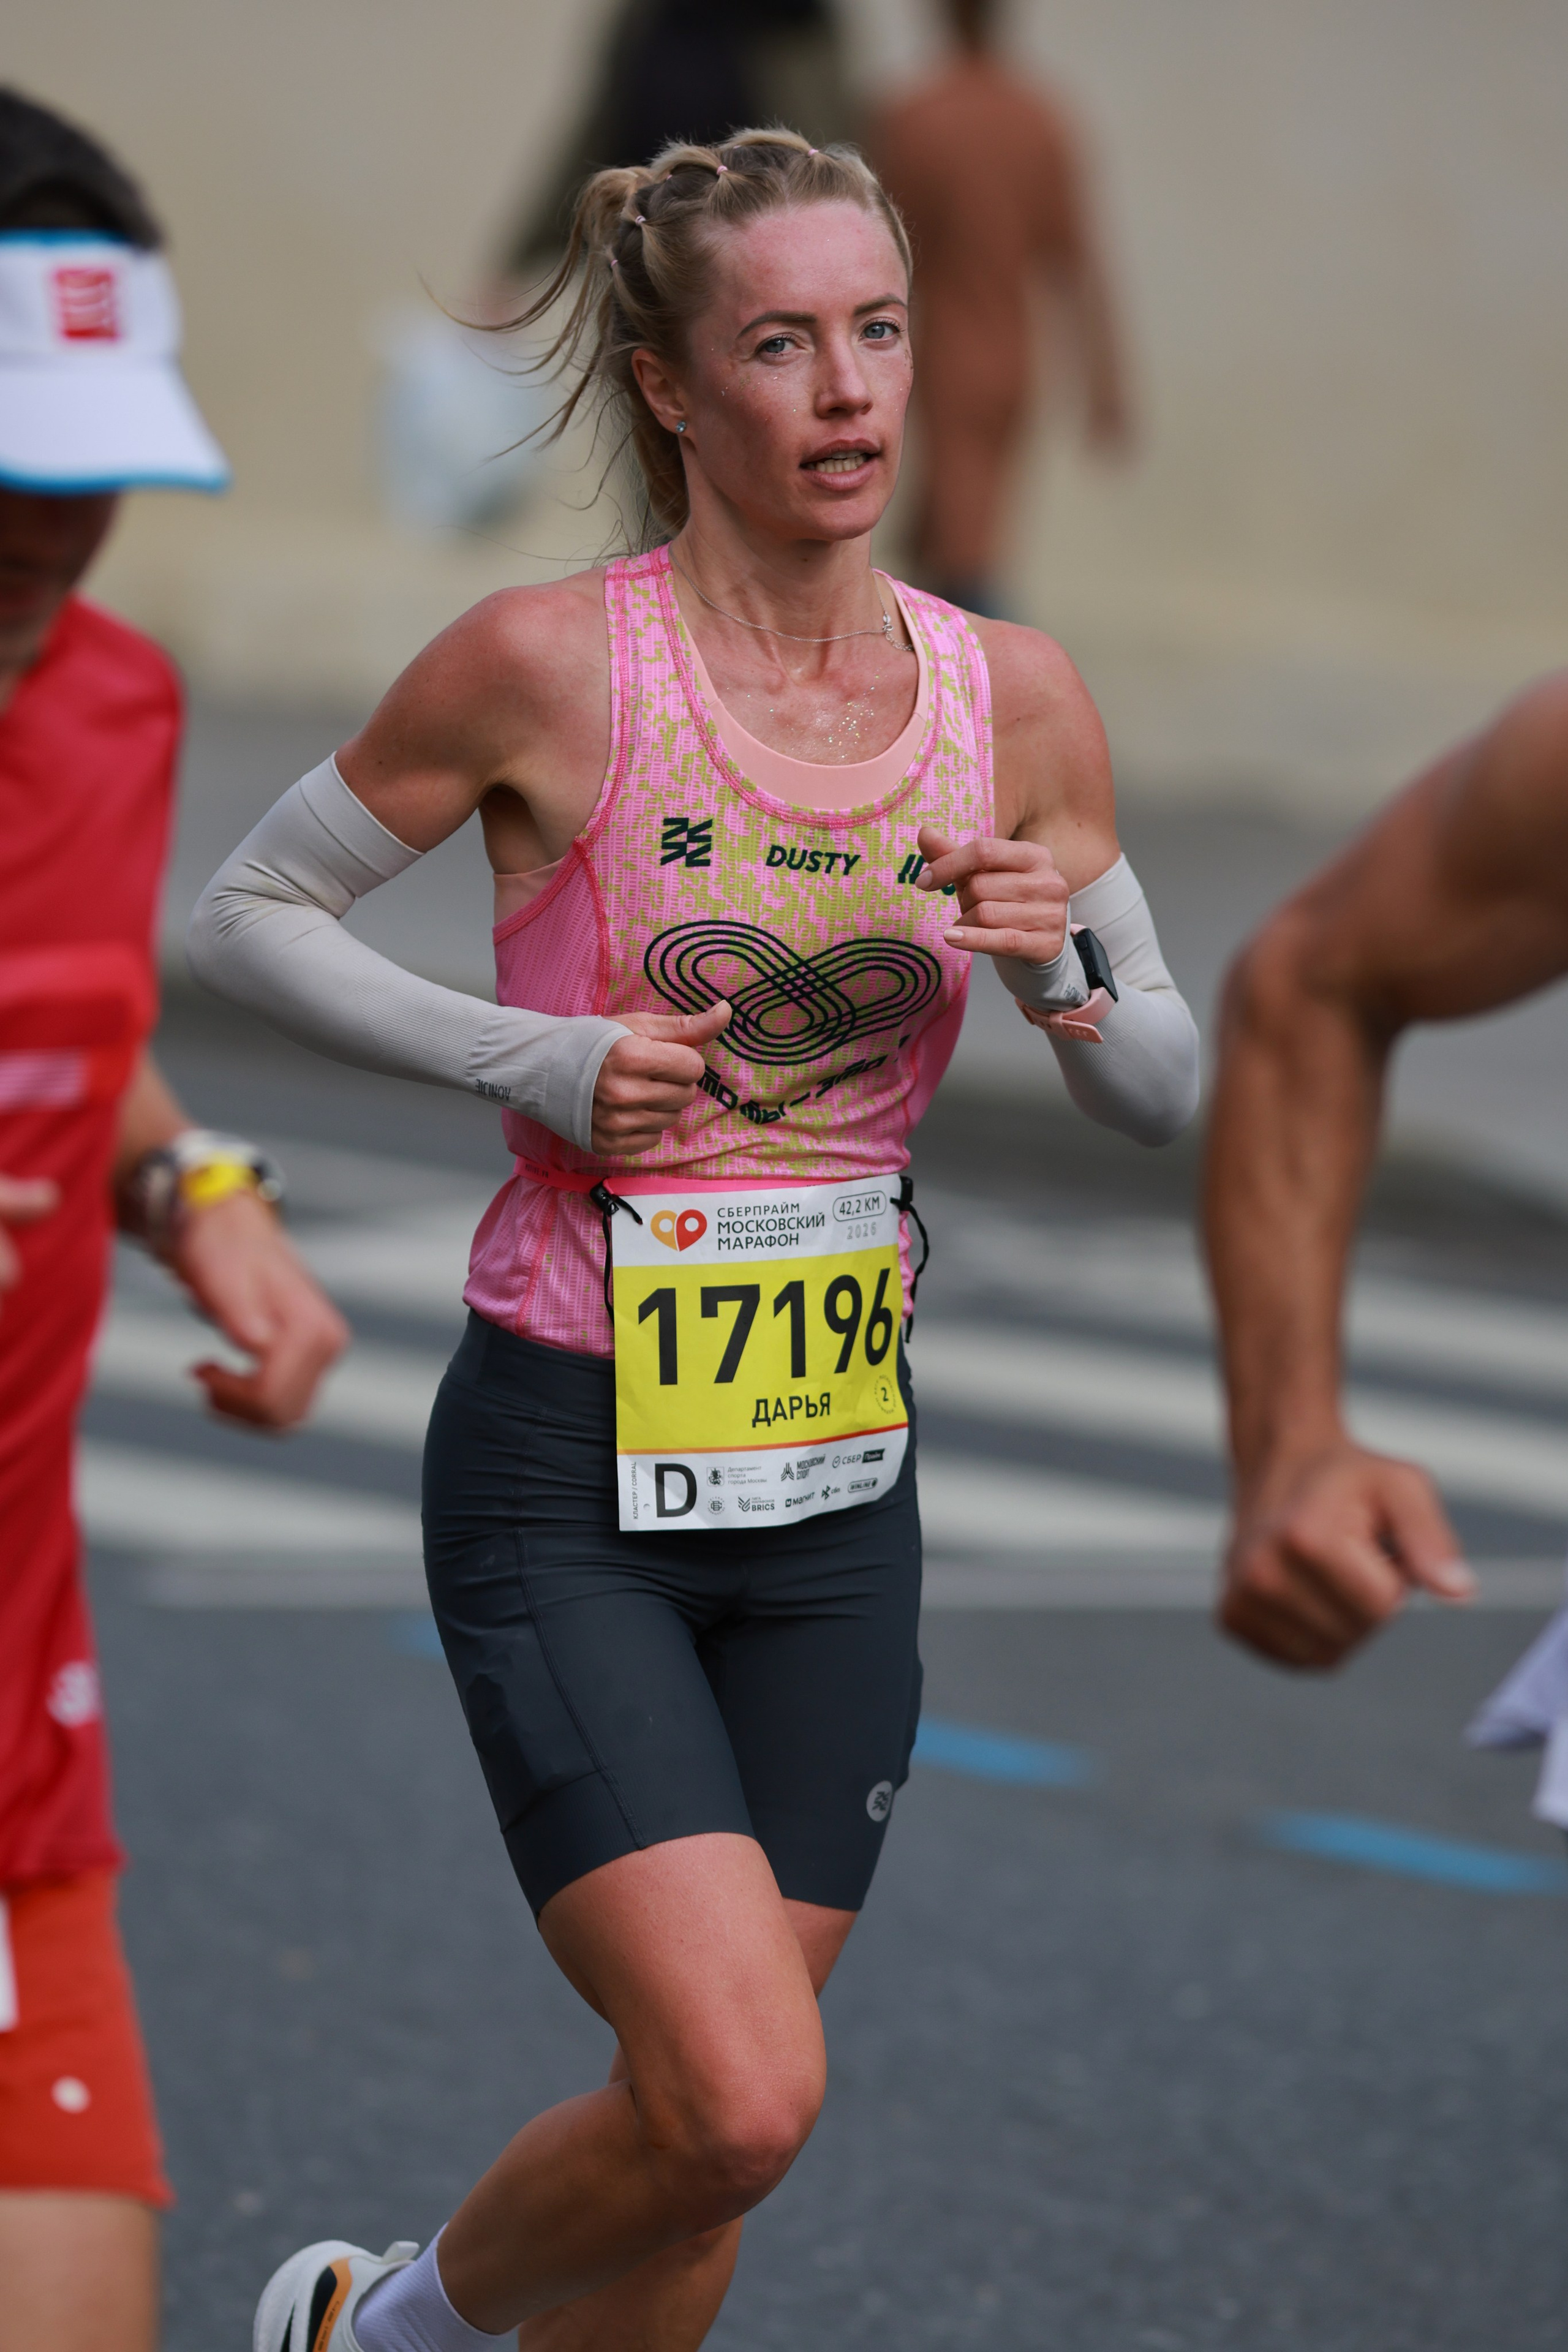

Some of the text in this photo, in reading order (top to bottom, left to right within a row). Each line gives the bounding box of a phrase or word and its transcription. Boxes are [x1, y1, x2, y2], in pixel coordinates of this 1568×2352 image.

[766, 845, 861, 875] DUSTY
[475, 1078, 512, 1101] AONIJIE
[717, 1202, 801, 1218] СБЕРПРАЙМ
[840, 1199, 861, 1216] 42,2
[717, 1212, 826, 1234] МОСКОВСКИЙ
[846, 1221, 876, 1240] 2026
[717, 1232, 799, 1251] МАРАФОН
[638, 1267, 894, 1385] 17196
[881, 1387, 889, 1401] 2
[751, 1392, 831, 1428] ДАРЬЯ
[796, 1453, 826, 1470] МОСКОВСКИЙ
[842, 1453, 861, 1464] СБЕР
[796, 1469, 810, 1480] СПОРТ
[655, 1463, 697, 1518] D
[850, 1481, 872, 1490] WINLINE
[752, 1503, 775, 1512] BRICS
